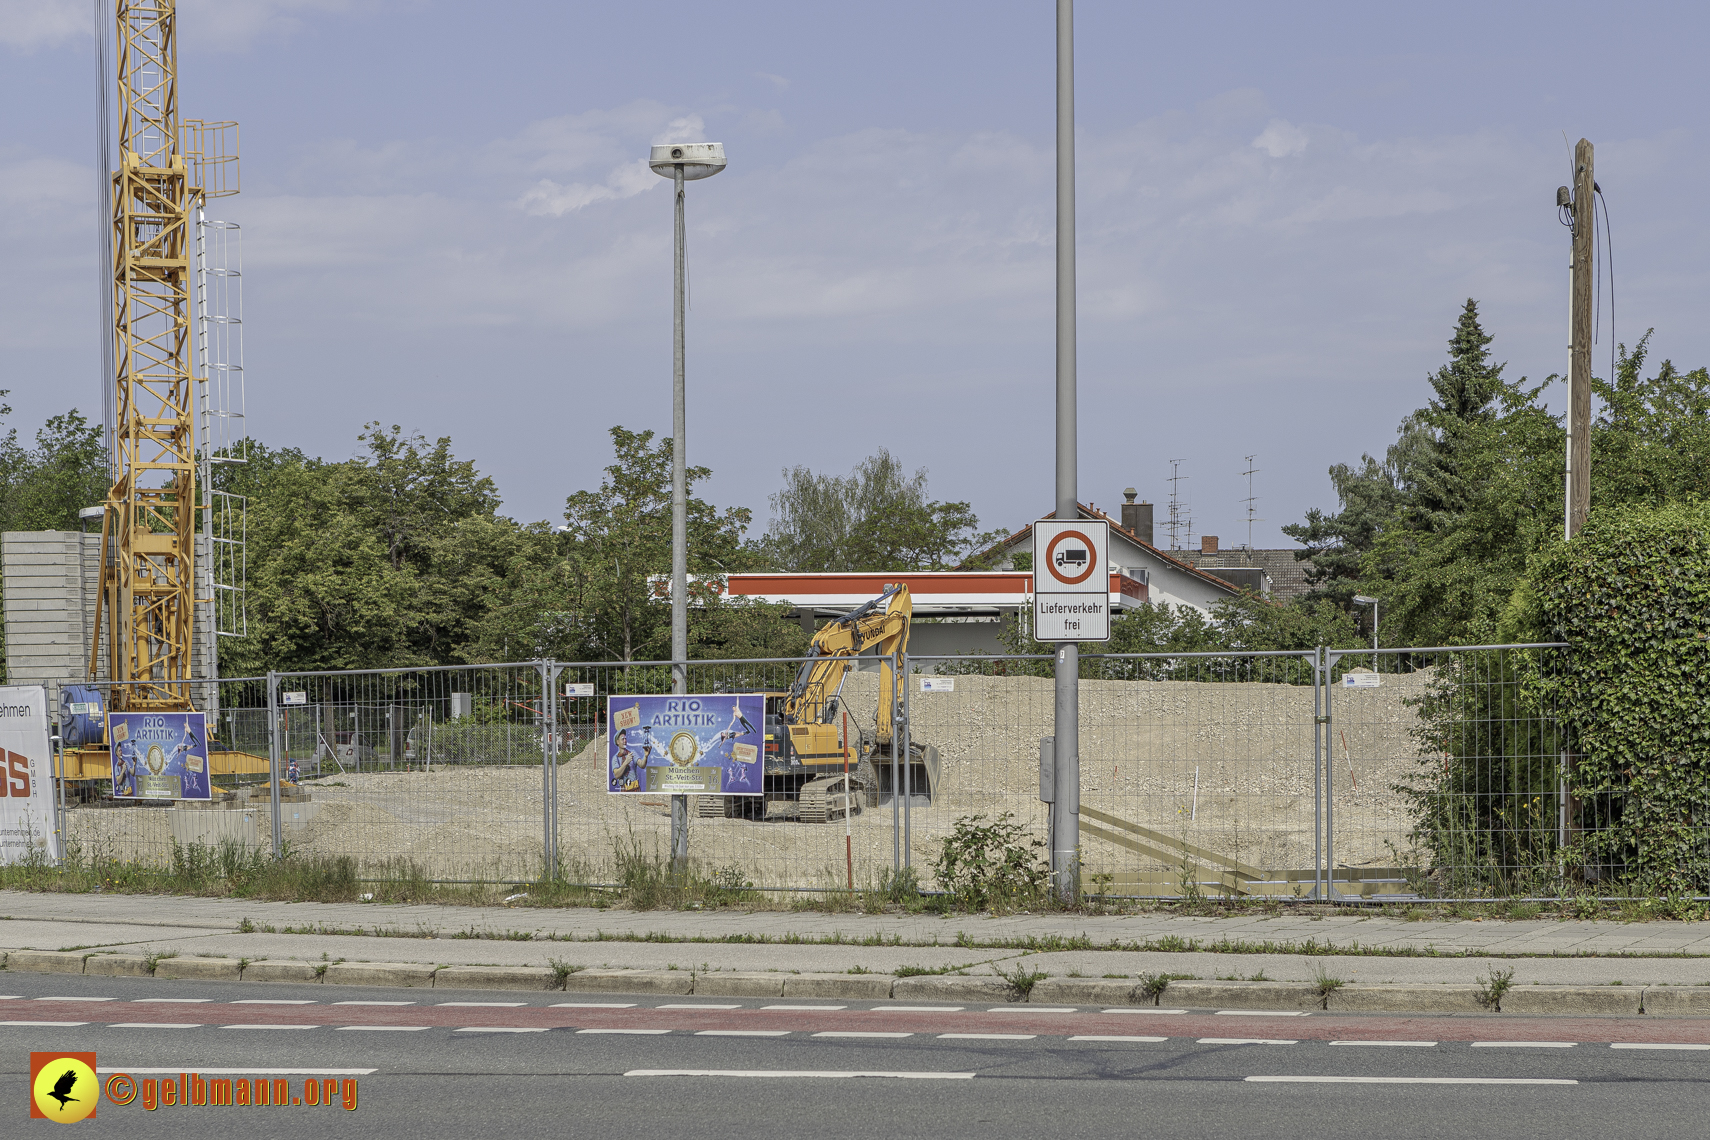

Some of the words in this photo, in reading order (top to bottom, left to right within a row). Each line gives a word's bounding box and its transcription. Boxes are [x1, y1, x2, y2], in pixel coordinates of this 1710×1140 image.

[1040, 602, 1103, 614] Lieferverkehr
[1064, 618, 1081, 631] frei
[859, 625, 886, 642] YUNDAI
[667, 700, 702, 712] RIO
[144, 717, 165, 728] RIO
[652, 714, 716, 727] ARTISTIK
[136, 729, 174, 740] ARTISTIK
